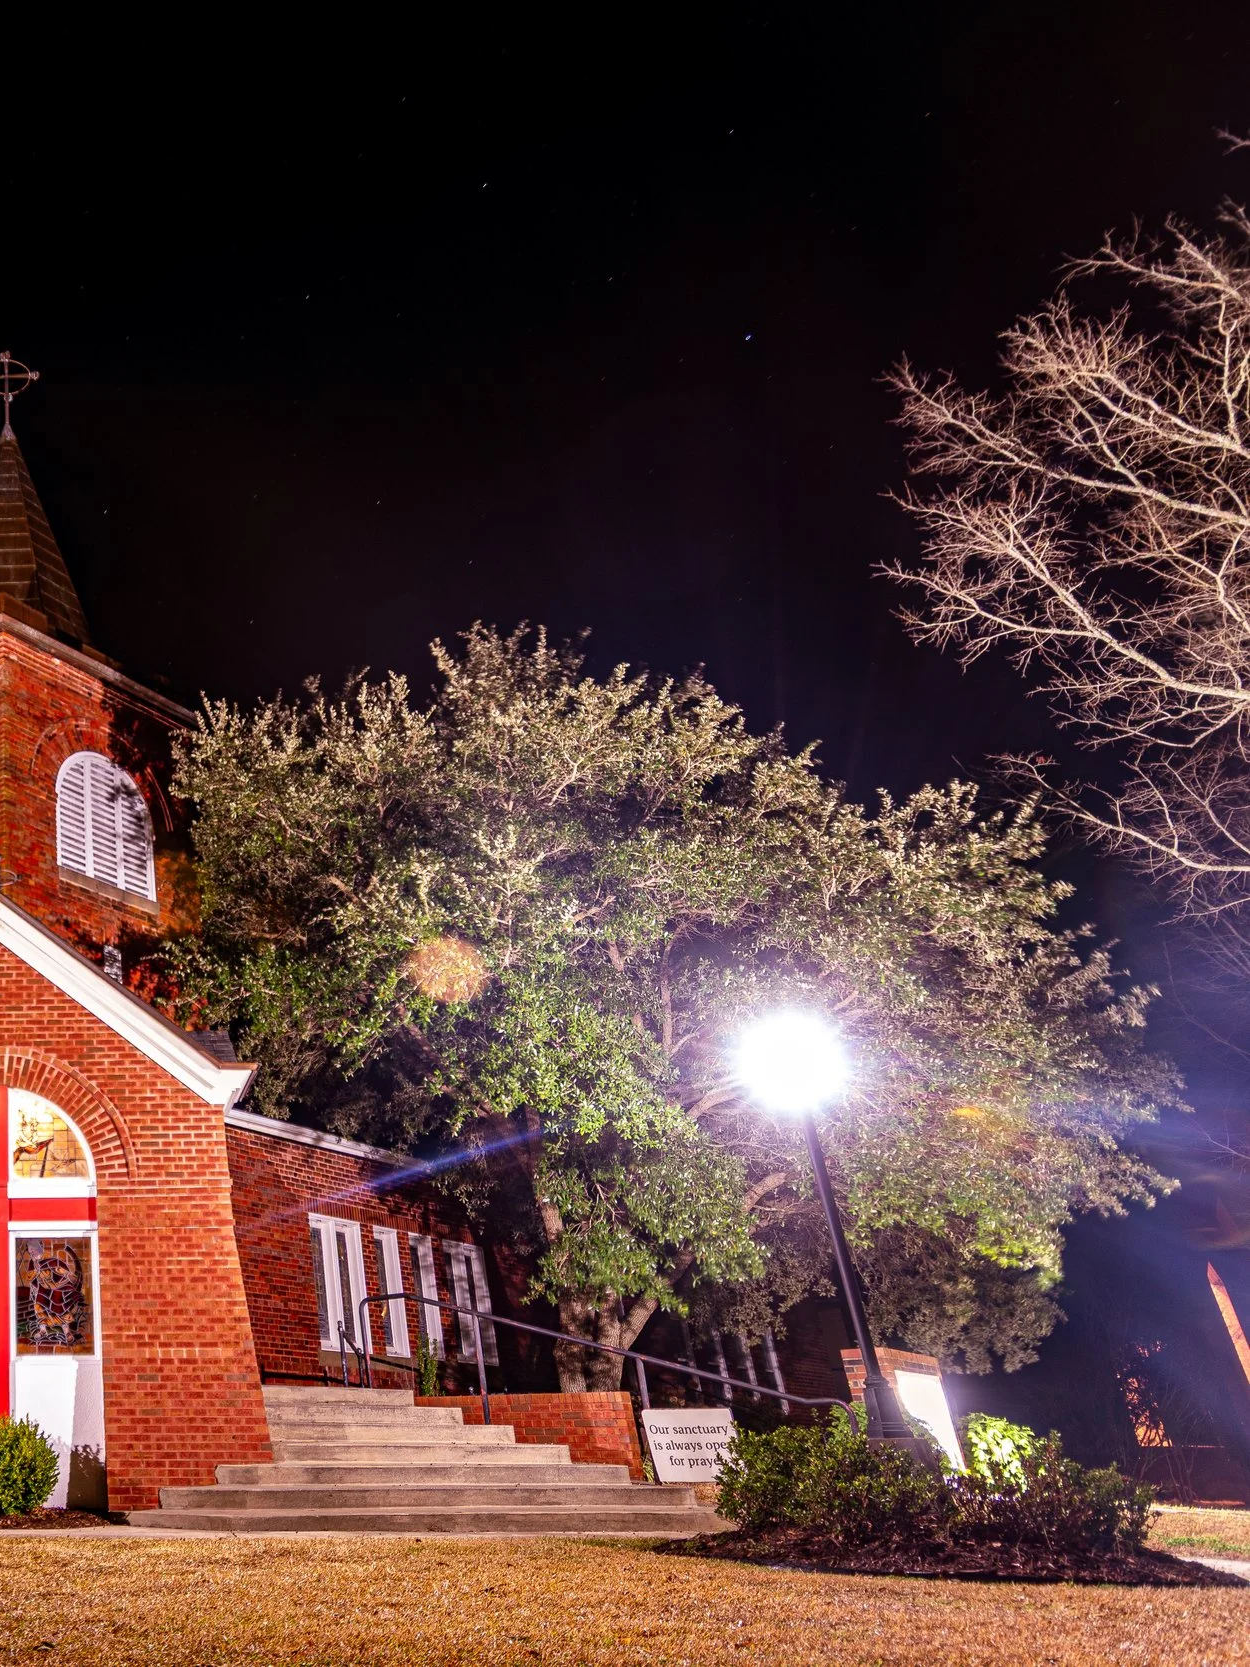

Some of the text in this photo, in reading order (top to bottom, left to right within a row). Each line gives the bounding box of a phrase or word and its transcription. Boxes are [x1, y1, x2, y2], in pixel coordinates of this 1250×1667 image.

[649, 1424, 729, 1436] Our sanctuary
[653, 1440, 727, 1453] is always ope
[669, 1455, 723, 1469] for praye
